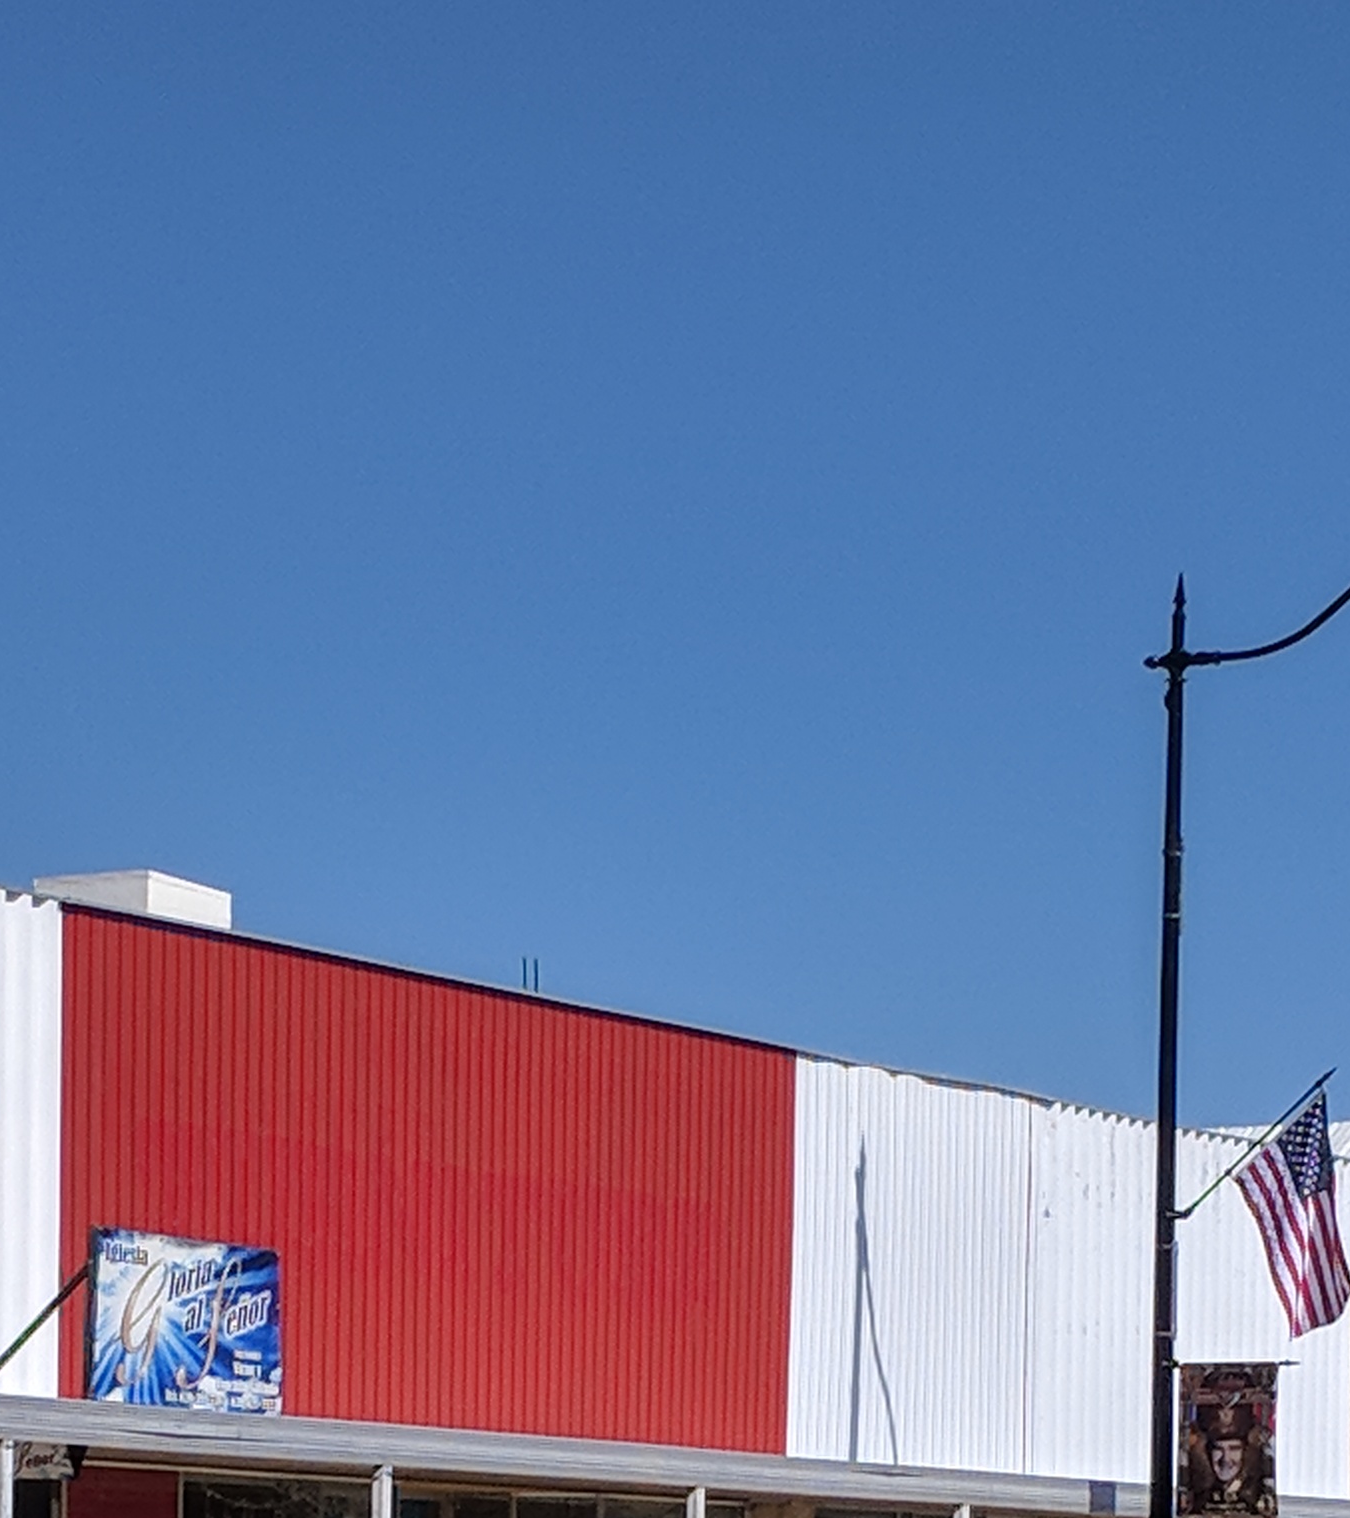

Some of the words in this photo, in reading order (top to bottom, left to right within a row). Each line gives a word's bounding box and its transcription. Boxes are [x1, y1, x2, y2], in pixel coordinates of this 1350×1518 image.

[104, 1240, 149, 1266] Iglesia
[115, 1257, 215, 1386] Gloria
[184, 1297, 206, 1333] al
